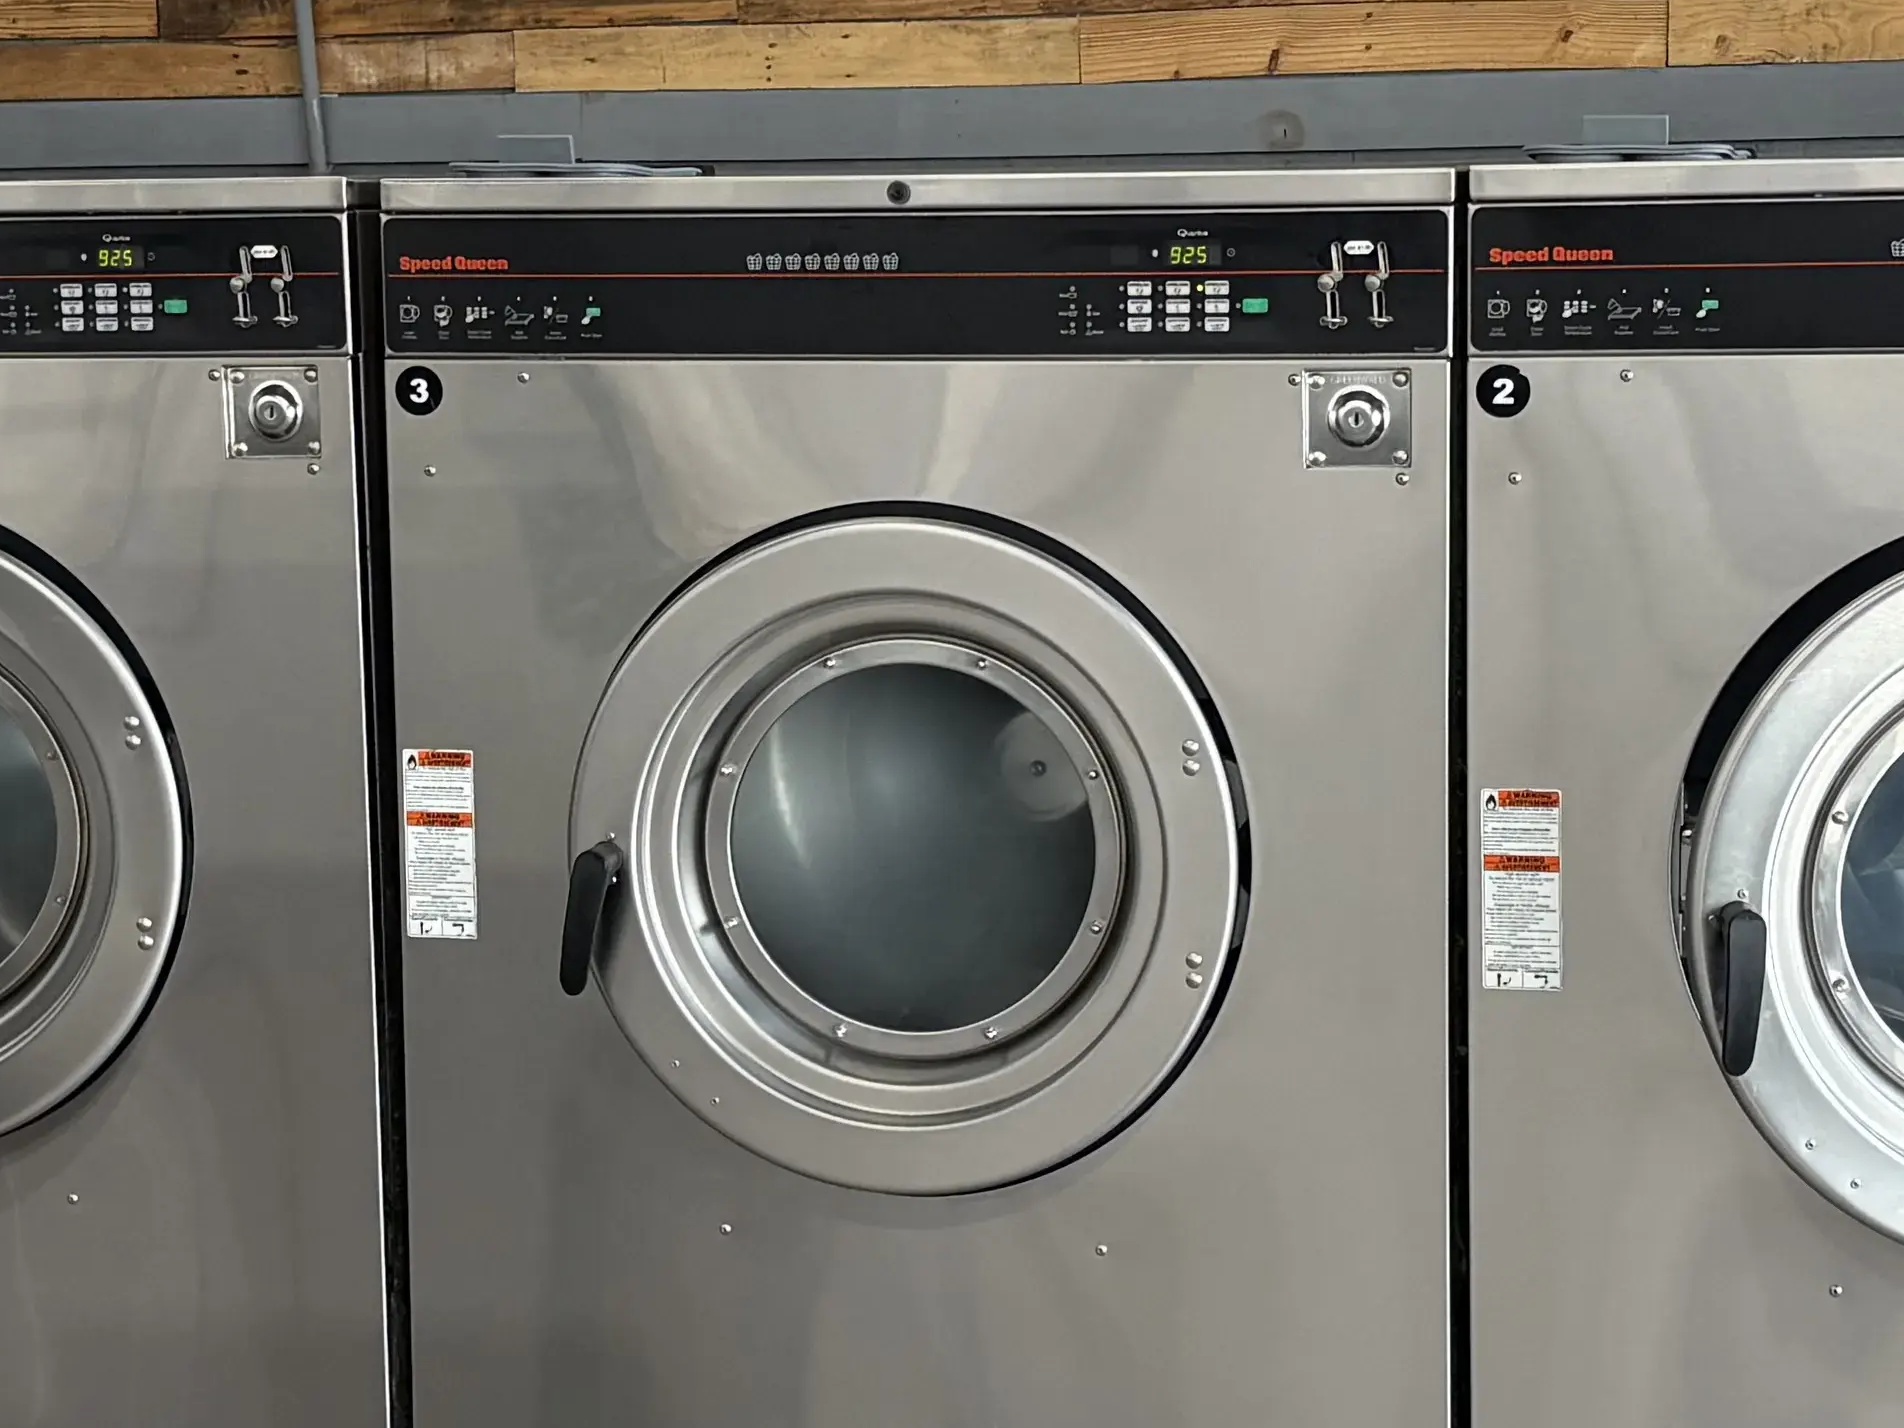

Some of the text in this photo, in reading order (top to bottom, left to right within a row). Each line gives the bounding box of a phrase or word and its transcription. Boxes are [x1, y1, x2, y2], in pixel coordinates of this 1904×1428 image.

[99, 249, 133, 267] 925
[399, 256, 508, 272] Speed Queen
[1170, 246, 1207, 264] 925
[1489, 246, 1614, 264] Speed Queen
[409, 378, 430, 404] 3
[1492, 377, 1515, 405] 2
